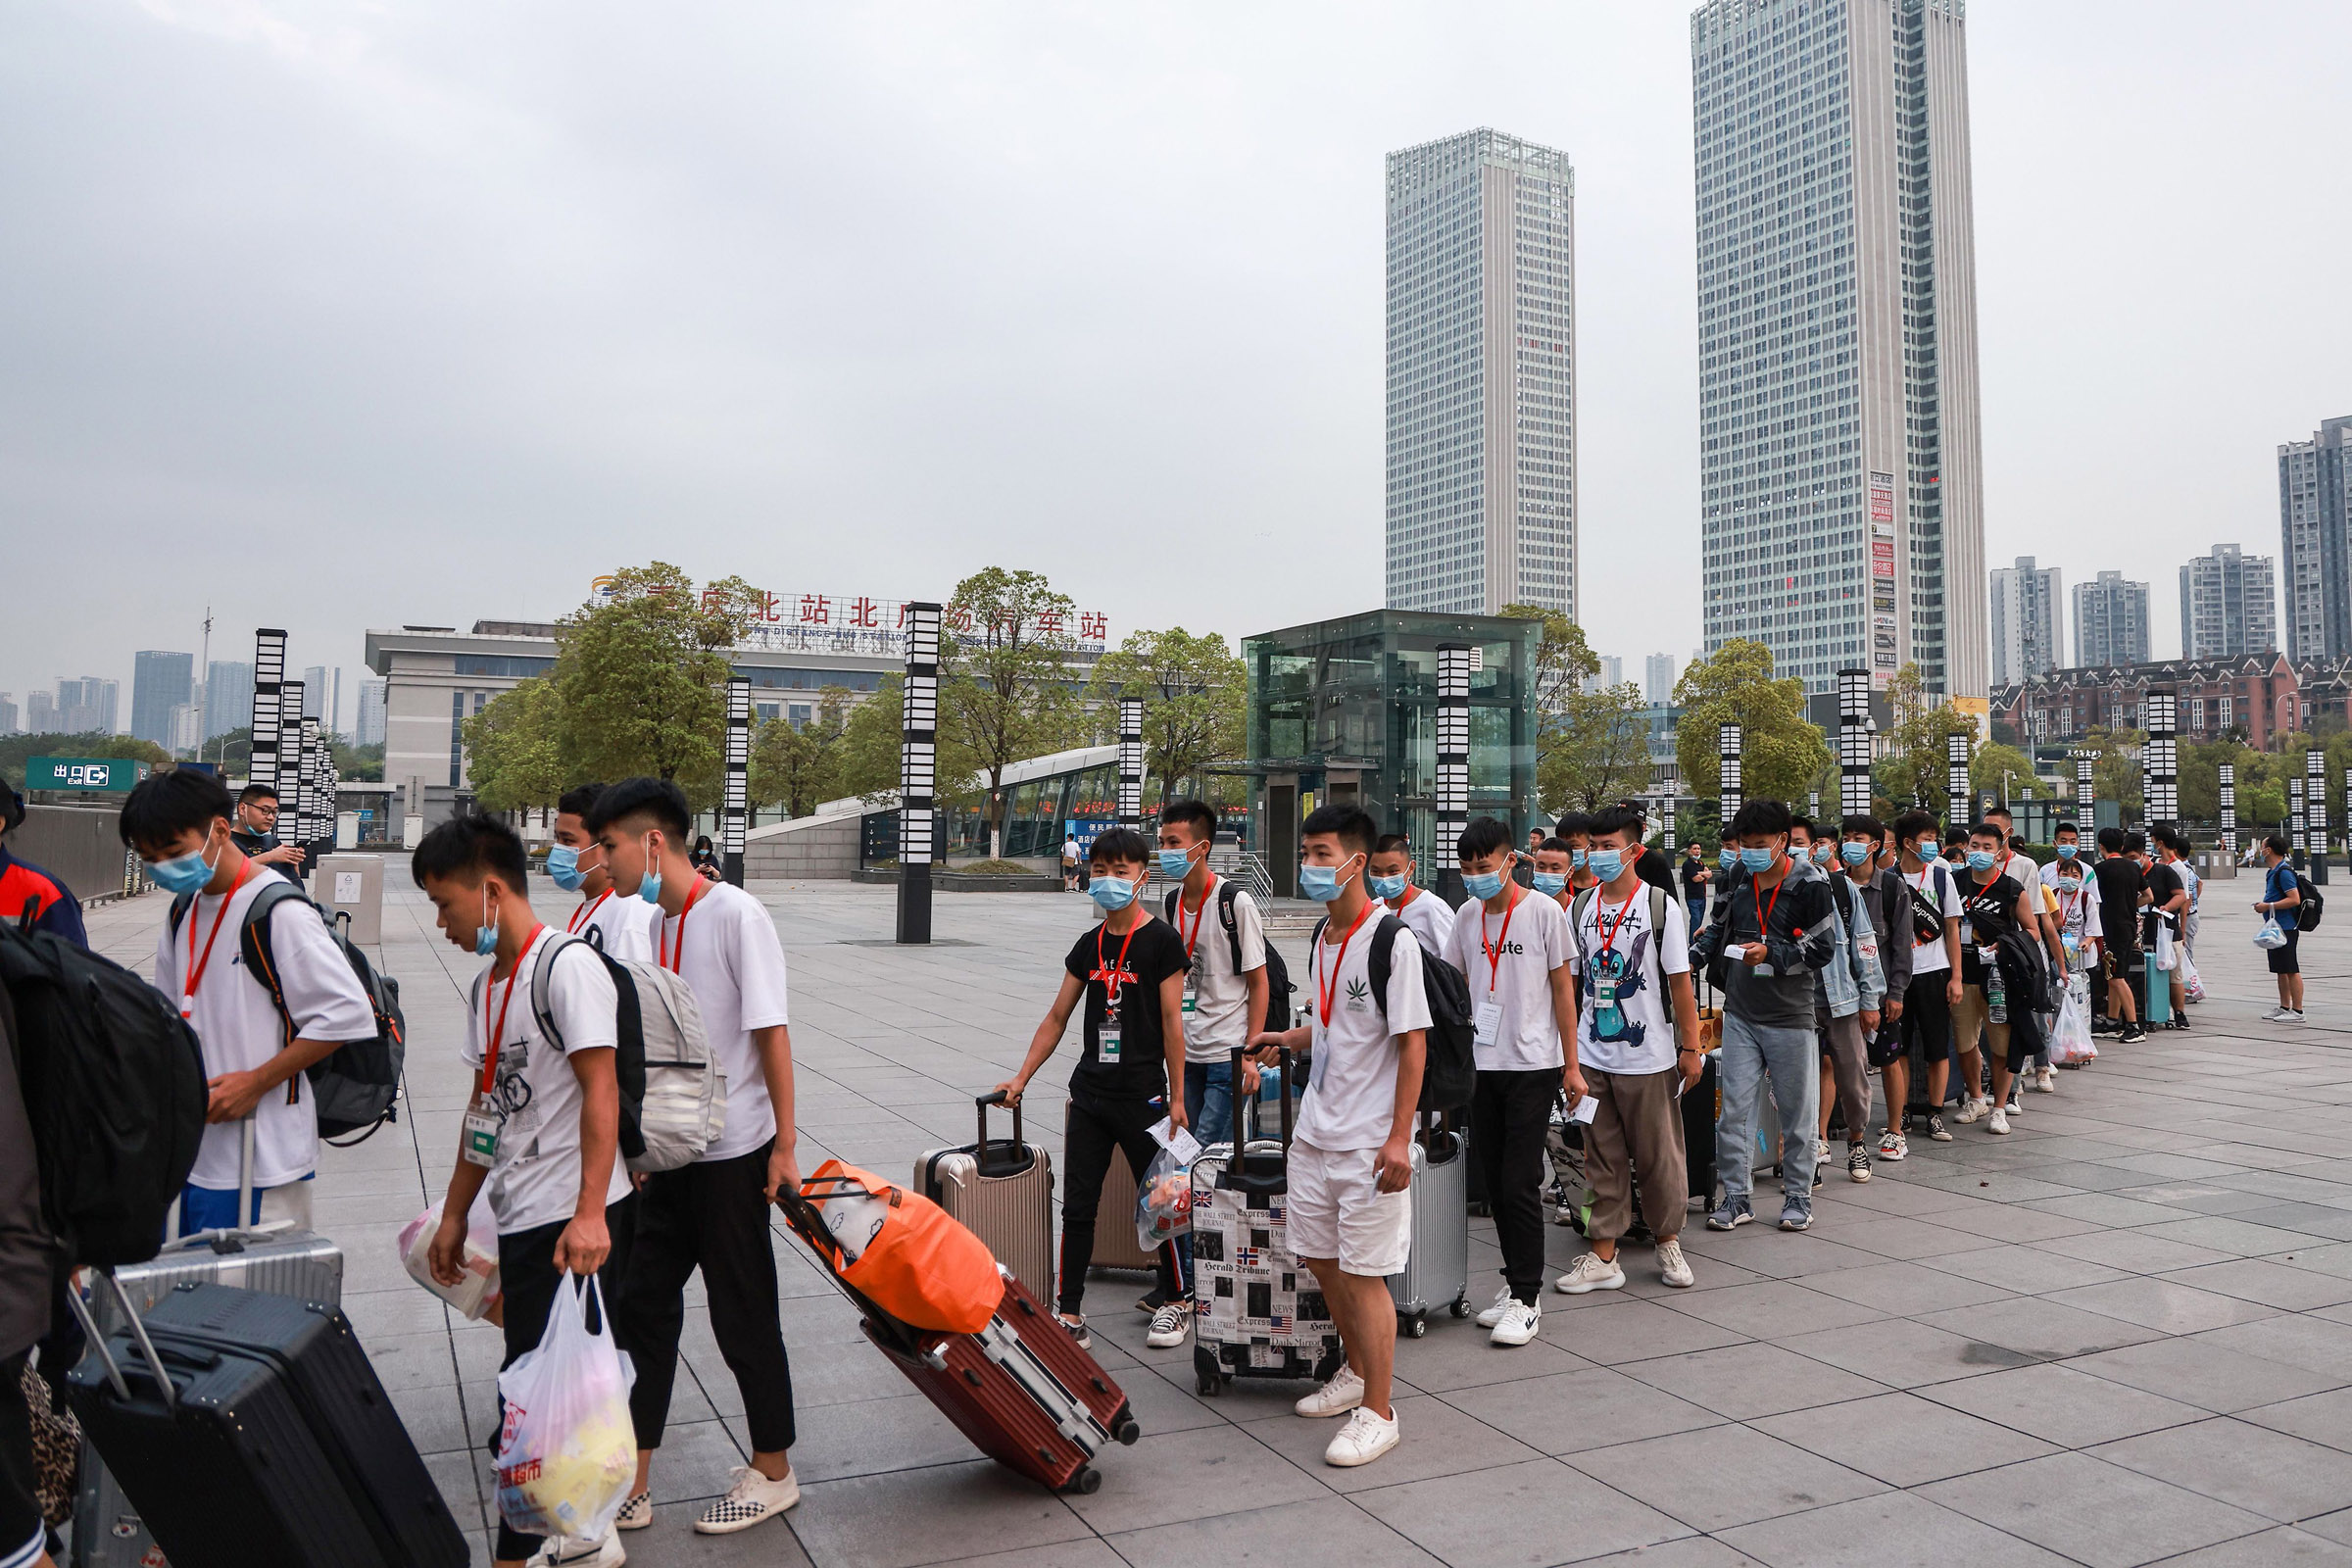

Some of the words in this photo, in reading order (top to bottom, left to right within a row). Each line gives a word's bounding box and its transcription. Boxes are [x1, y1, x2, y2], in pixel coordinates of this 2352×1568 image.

[773, 627, 830, 638] DISTANCE
[1063, 643, 1105, 653] SATION
[54, 763, 84, 777] 出口
[1911, 901, 1940, 931] Supreme
[1481, 940, 1523, 955] Salute
[1218, 1212, 1235, 1221] STREET
[1237, 1208, 1270, 1219] Express
[1202, 1218, 1225, 1227] JOURNAL
[1204, 1261, 1234, 1272] Herald
[1235, 1264, 1271, 1275] Tribune
[1272, 1304, 1294, 1313] NEWS
[1237, 1315, 1271, 1326] Express
[1271, 1337, 1292, 1347] Daily
[1295, 1338, 1322, 1347] Mirror
